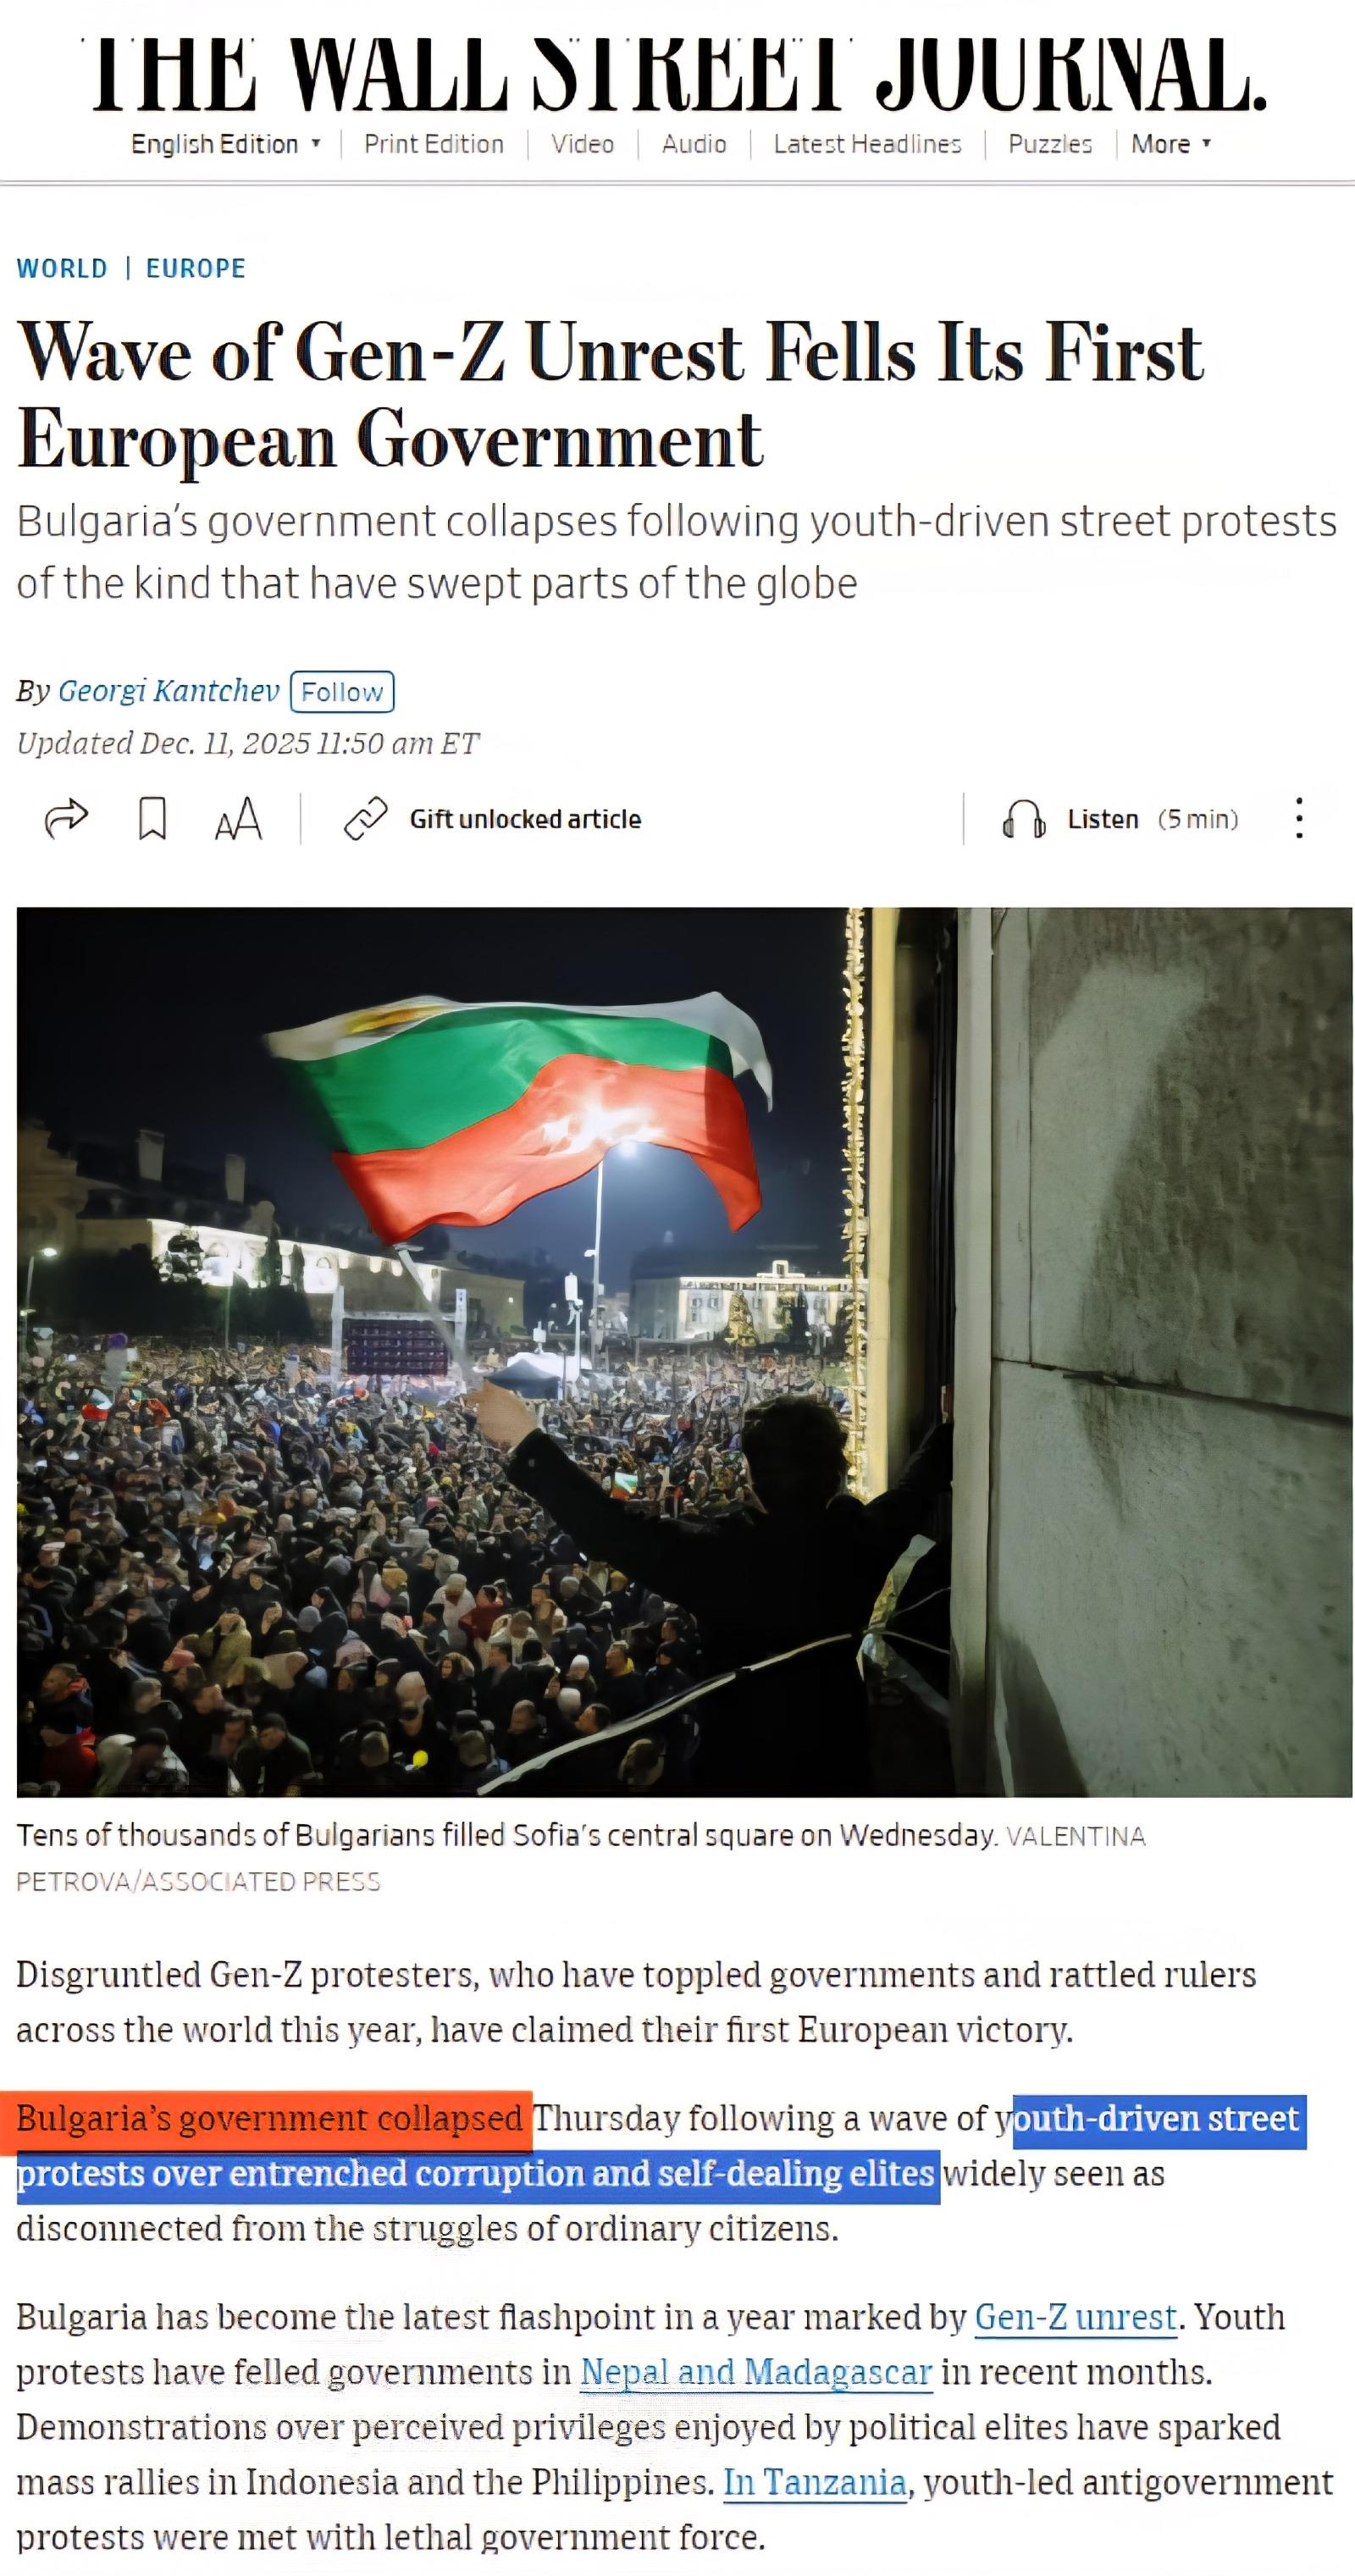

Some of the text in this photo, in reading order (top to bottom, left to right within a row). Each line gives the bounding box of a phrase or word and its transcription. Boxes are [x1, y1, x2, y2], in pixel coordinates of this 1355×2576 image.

[80, 37, 1267, 113] THE WALL STREET JOURNAL.
[132, 133, 1191, 159] English Edition Print Edition Video Audio Latest Headlines Puzzles More
[16, 257, 246, 279] WORLD EUROPE
[16, 319, 1205, 382] Wave of Gen-Z Unrest Fells Its First
[17, 406, 765, 484] European Government
[208, 505, 437, 544] government
[447, 502, 617, 544] collapses
[627, 502, 798, 544] following
[810, 502, 1048, 544] youth-driven
[1061, 505, 1171, 537] street
[1183, 504, 1337, 544] protests
[17, 564, 858, 606] of the kind that have swept parts of the globe
[14, 677, 281, 707] By Georgi Kantchev
[302, 681, 384, 702] Follow
[19, 729, 482, 760] Updated Dec. 11, 2025 11:50 am ET
[410, 808, 642, 830] Gift unlocked article
[1069, 808, 1238, 832] Listen (5 min)
[16, 1823, 78, 1847] Tens
[86, 1821, 113, 1847] of
[117, 1821, 257, 1847] thousands
[263, 1821, 291, 1847] of
[296, 1821, 434, 1852] Bulgarians
[442, 1821, 505, 1847] filled
[608, 1821, 698, 1847] central
[705, 1828, 794, 1851] square
[801, 1828, 832, 1847] on
[839, 1821, 999, 1851] Wednesday.
[1006, 1826, 1147, 1847] VALENTINA
[17, 1869, 380, 1892] PETROVA/ASSOCIATED PRESS
[16, 1960, 1257, 1995] Disgruntled Gen-Z protesters, who have toppled governments and rattled rulers
[16, 2015, 1073, 2050] across the world this year, have claimed their first European victory.
[179, 2109, 368, 2139] government
[378, 2103, 524, 2139] collapsed
[536, 2103, 682, 2139] Thursday
[689, 2103, 836, 2139] following
[843, 2110, 861, 2131] a
[868, 2110, 948, 2131] wave
[957, 2103, 990, 2131] of
[993, 2103, 1201, 2139] youth-driven
[1208, 2106, 1300, 2132] street
[16, 2158, 1165, 2194] protests over entrenched corruption and self-dealing elites widely seen as
[16, 2302, 1286, 2337] Bulgaria has become the latest flashpoint in a year marked by Gen-Z unrest. Youth
[16, 2357, 1212, 2393] protests have felled governments in Nepal and Madagascar in recent months.
[16, 2467, 1335, 2502] mass rallies in Indonesia and the Philippines. In Tanzania, youth-led antigovernment
